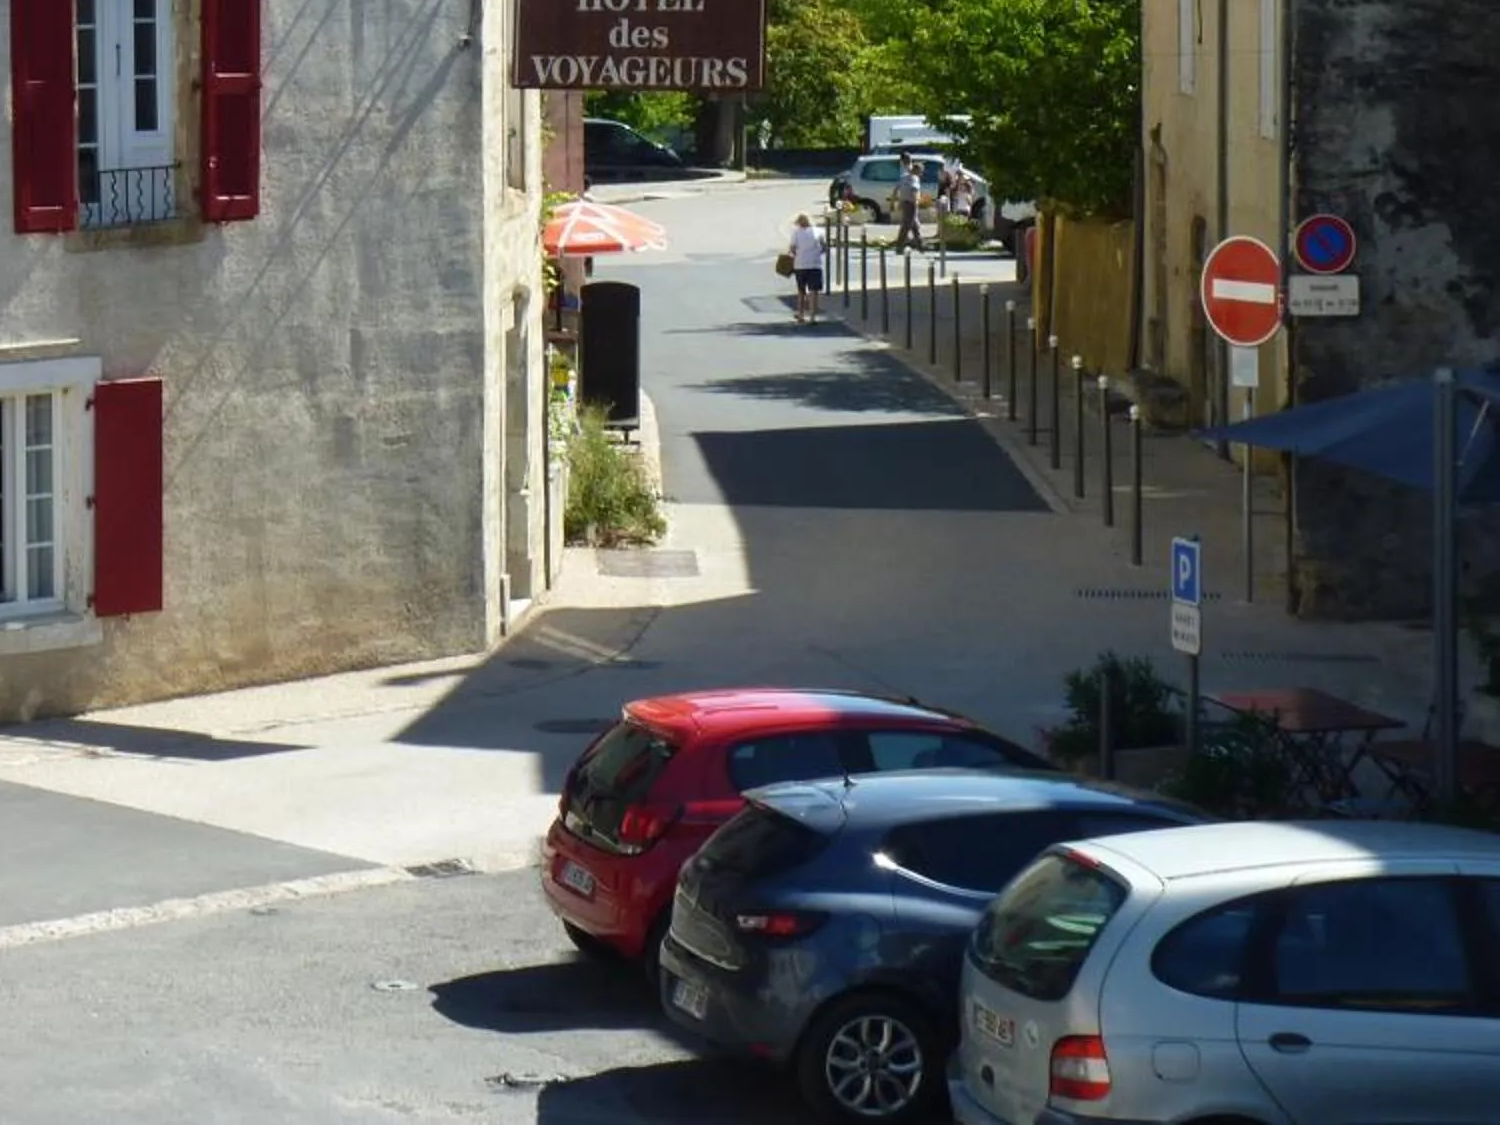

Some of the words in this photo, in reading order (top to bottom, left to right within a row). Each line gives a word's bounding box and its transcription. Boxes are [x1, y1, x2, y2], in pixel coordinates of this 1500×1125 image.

[609, 18, 669, 48] des
[531, 55, 748, 87] VOYAGEURS
[1179, 554, 1191, 590] P
